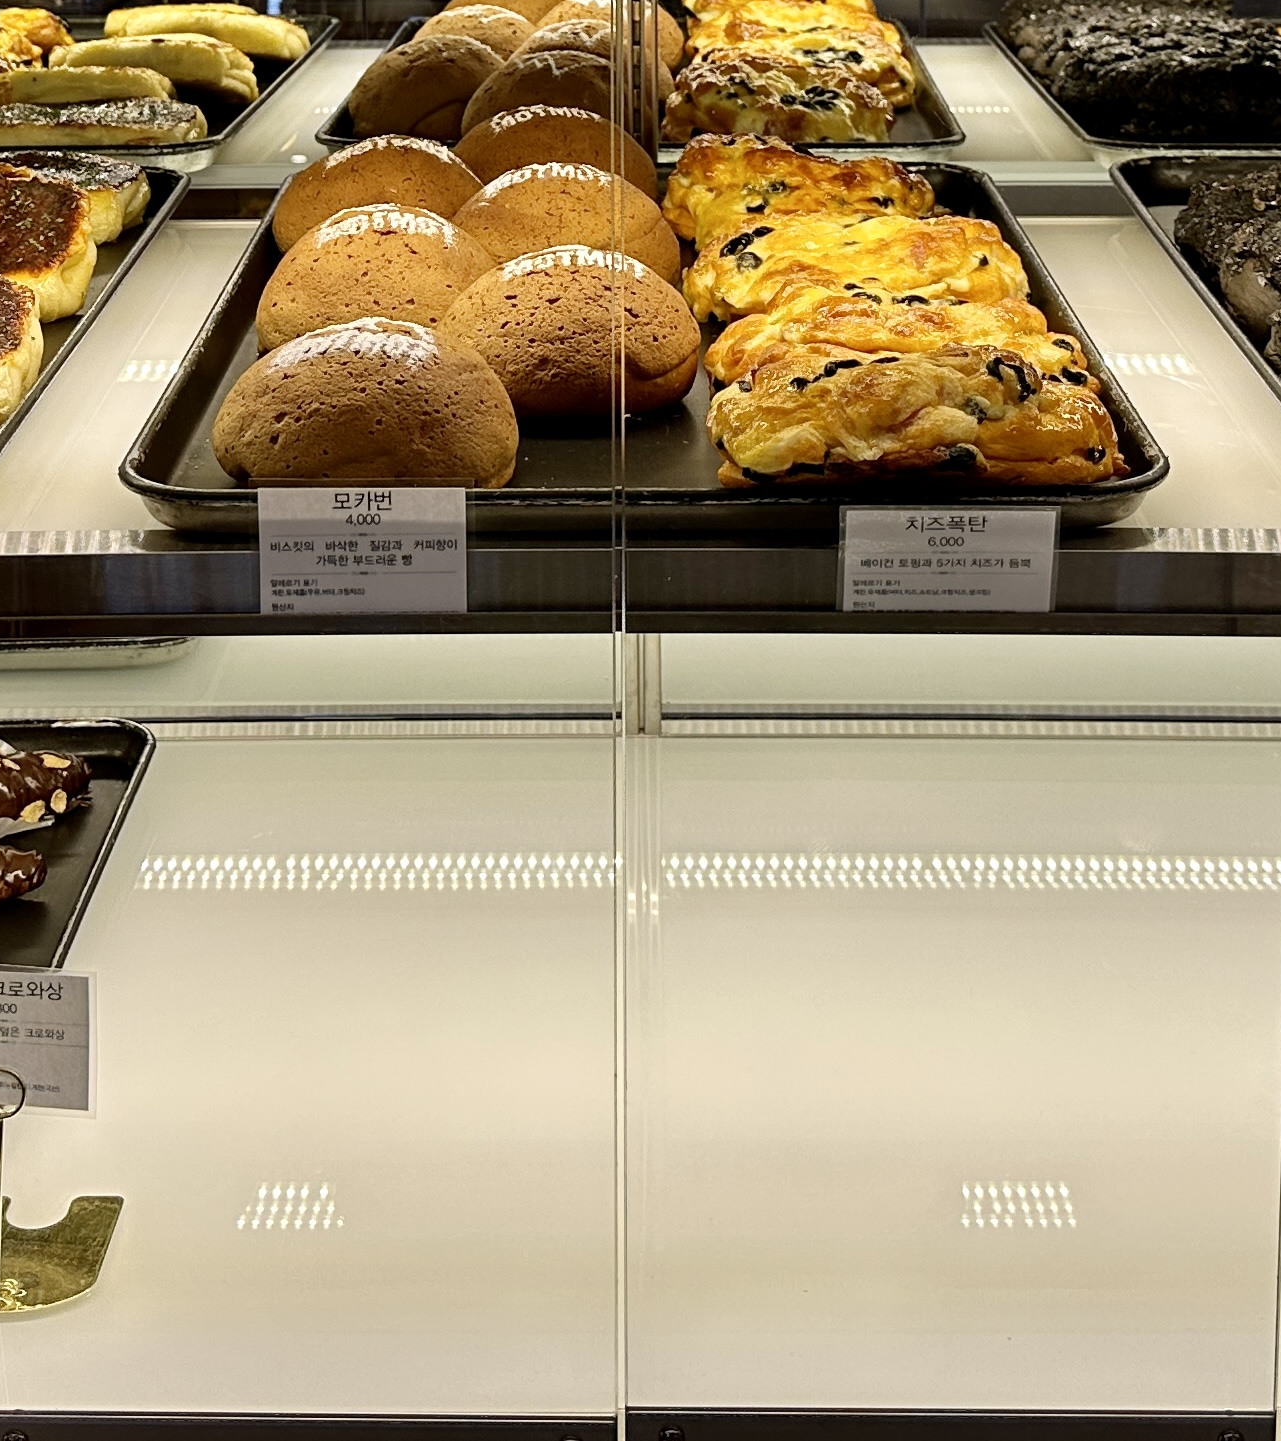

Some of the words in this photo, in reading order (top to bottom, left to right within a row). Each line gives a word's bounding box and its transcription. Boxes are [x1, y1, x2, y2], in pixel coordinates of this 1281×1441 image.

[332, 490, 393, 511] 모카번
[345, 513, 381, 526] 4,000
[905, 515, 988, 533] 치즈폭탄
[270, 541, 314, 553] 비스킷의
[325, 540, 359, 552] 바삭한
[370, 539, 403, 551] 질감과
[413, 538, 458, 551] 커피향이
[927, 536, 965, 548] 6,000
[316, 554, 349, 567] 가득한
[353, 554, 398, 566] 부드러운
[401, 553, 413, 566] 빵
[860, 558, 894, 568] 베이컨
[898, 558, 932, 568] 토핑과
[936, 558, 966, 568] 5가지
[970, 558, 1004, 568] 치즈가
[1008, 558, 1031, 568] 듬뿍
[24, 1028, 65, 1041] 크로와상
